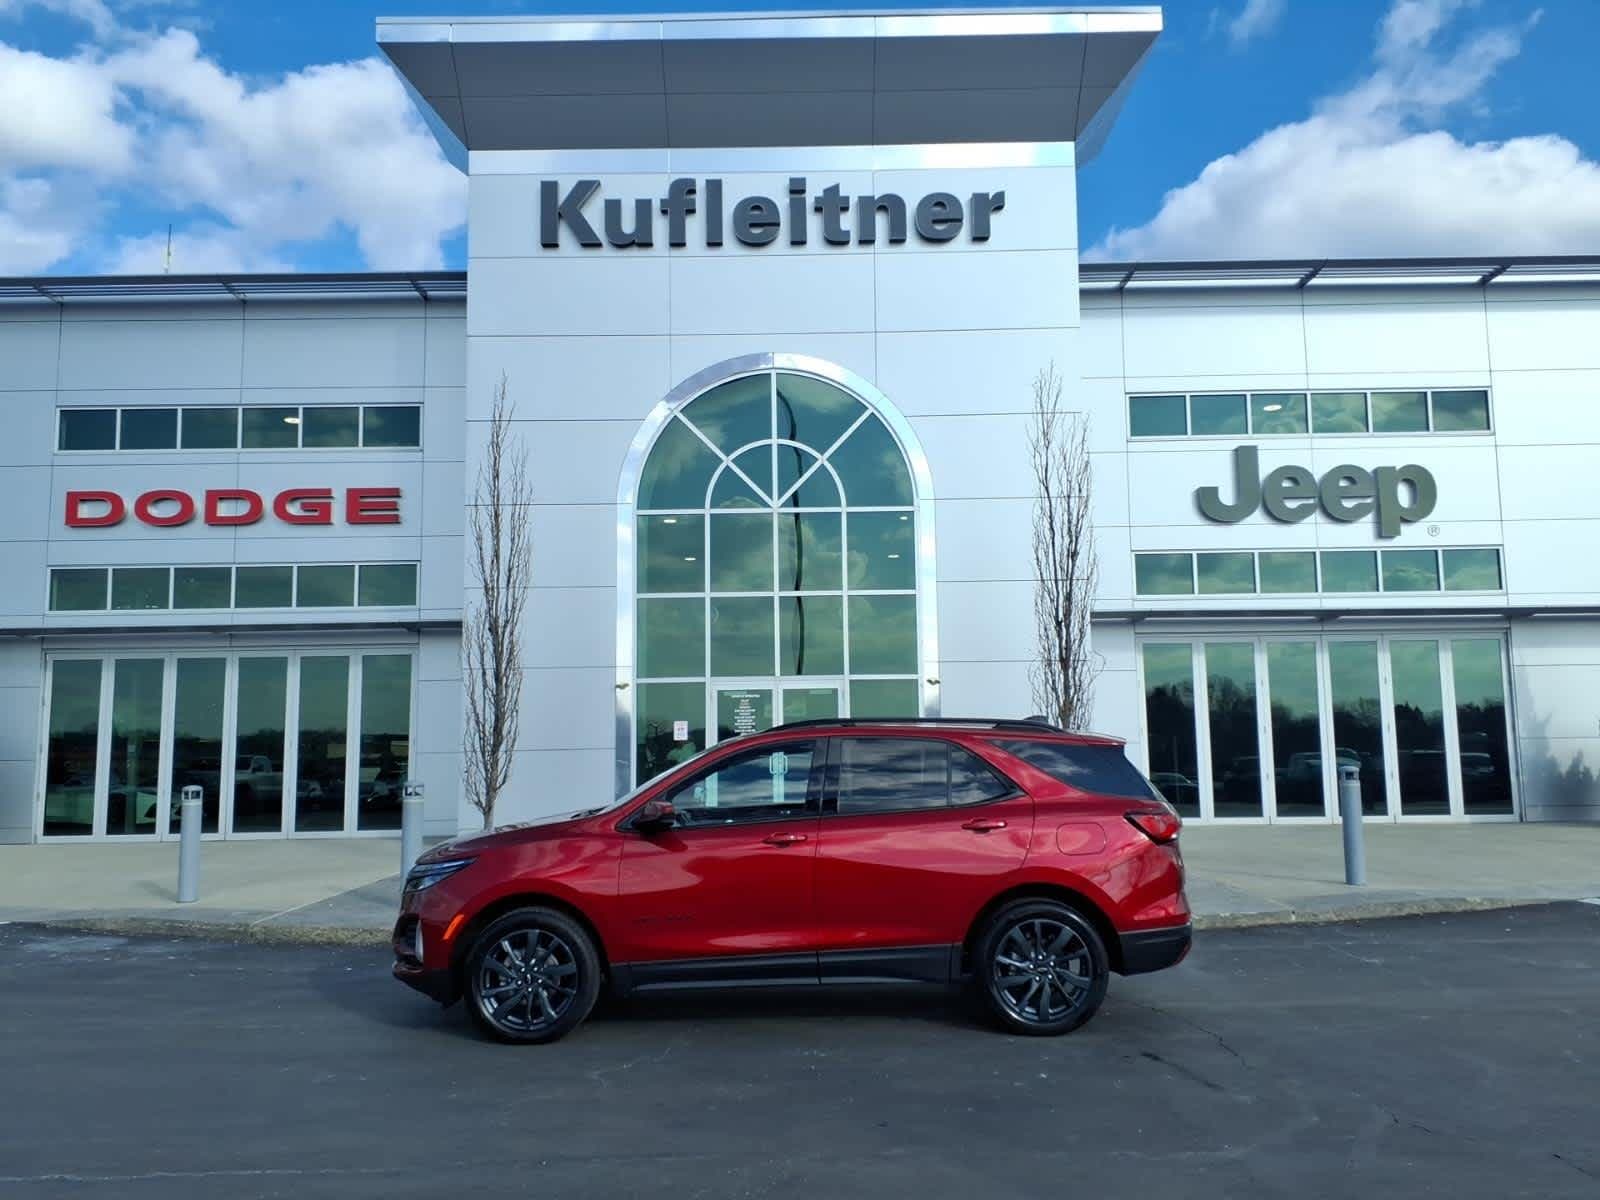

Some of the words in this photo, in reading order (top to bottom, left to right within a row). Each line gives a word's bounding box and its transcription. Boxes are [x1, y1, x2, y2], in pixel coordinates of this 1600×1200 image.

[540, 177, 1005, 249] Kufleitner
[64, 487, 402, 527] DODGE
[1196, 445, 1437, 539] Jeep
